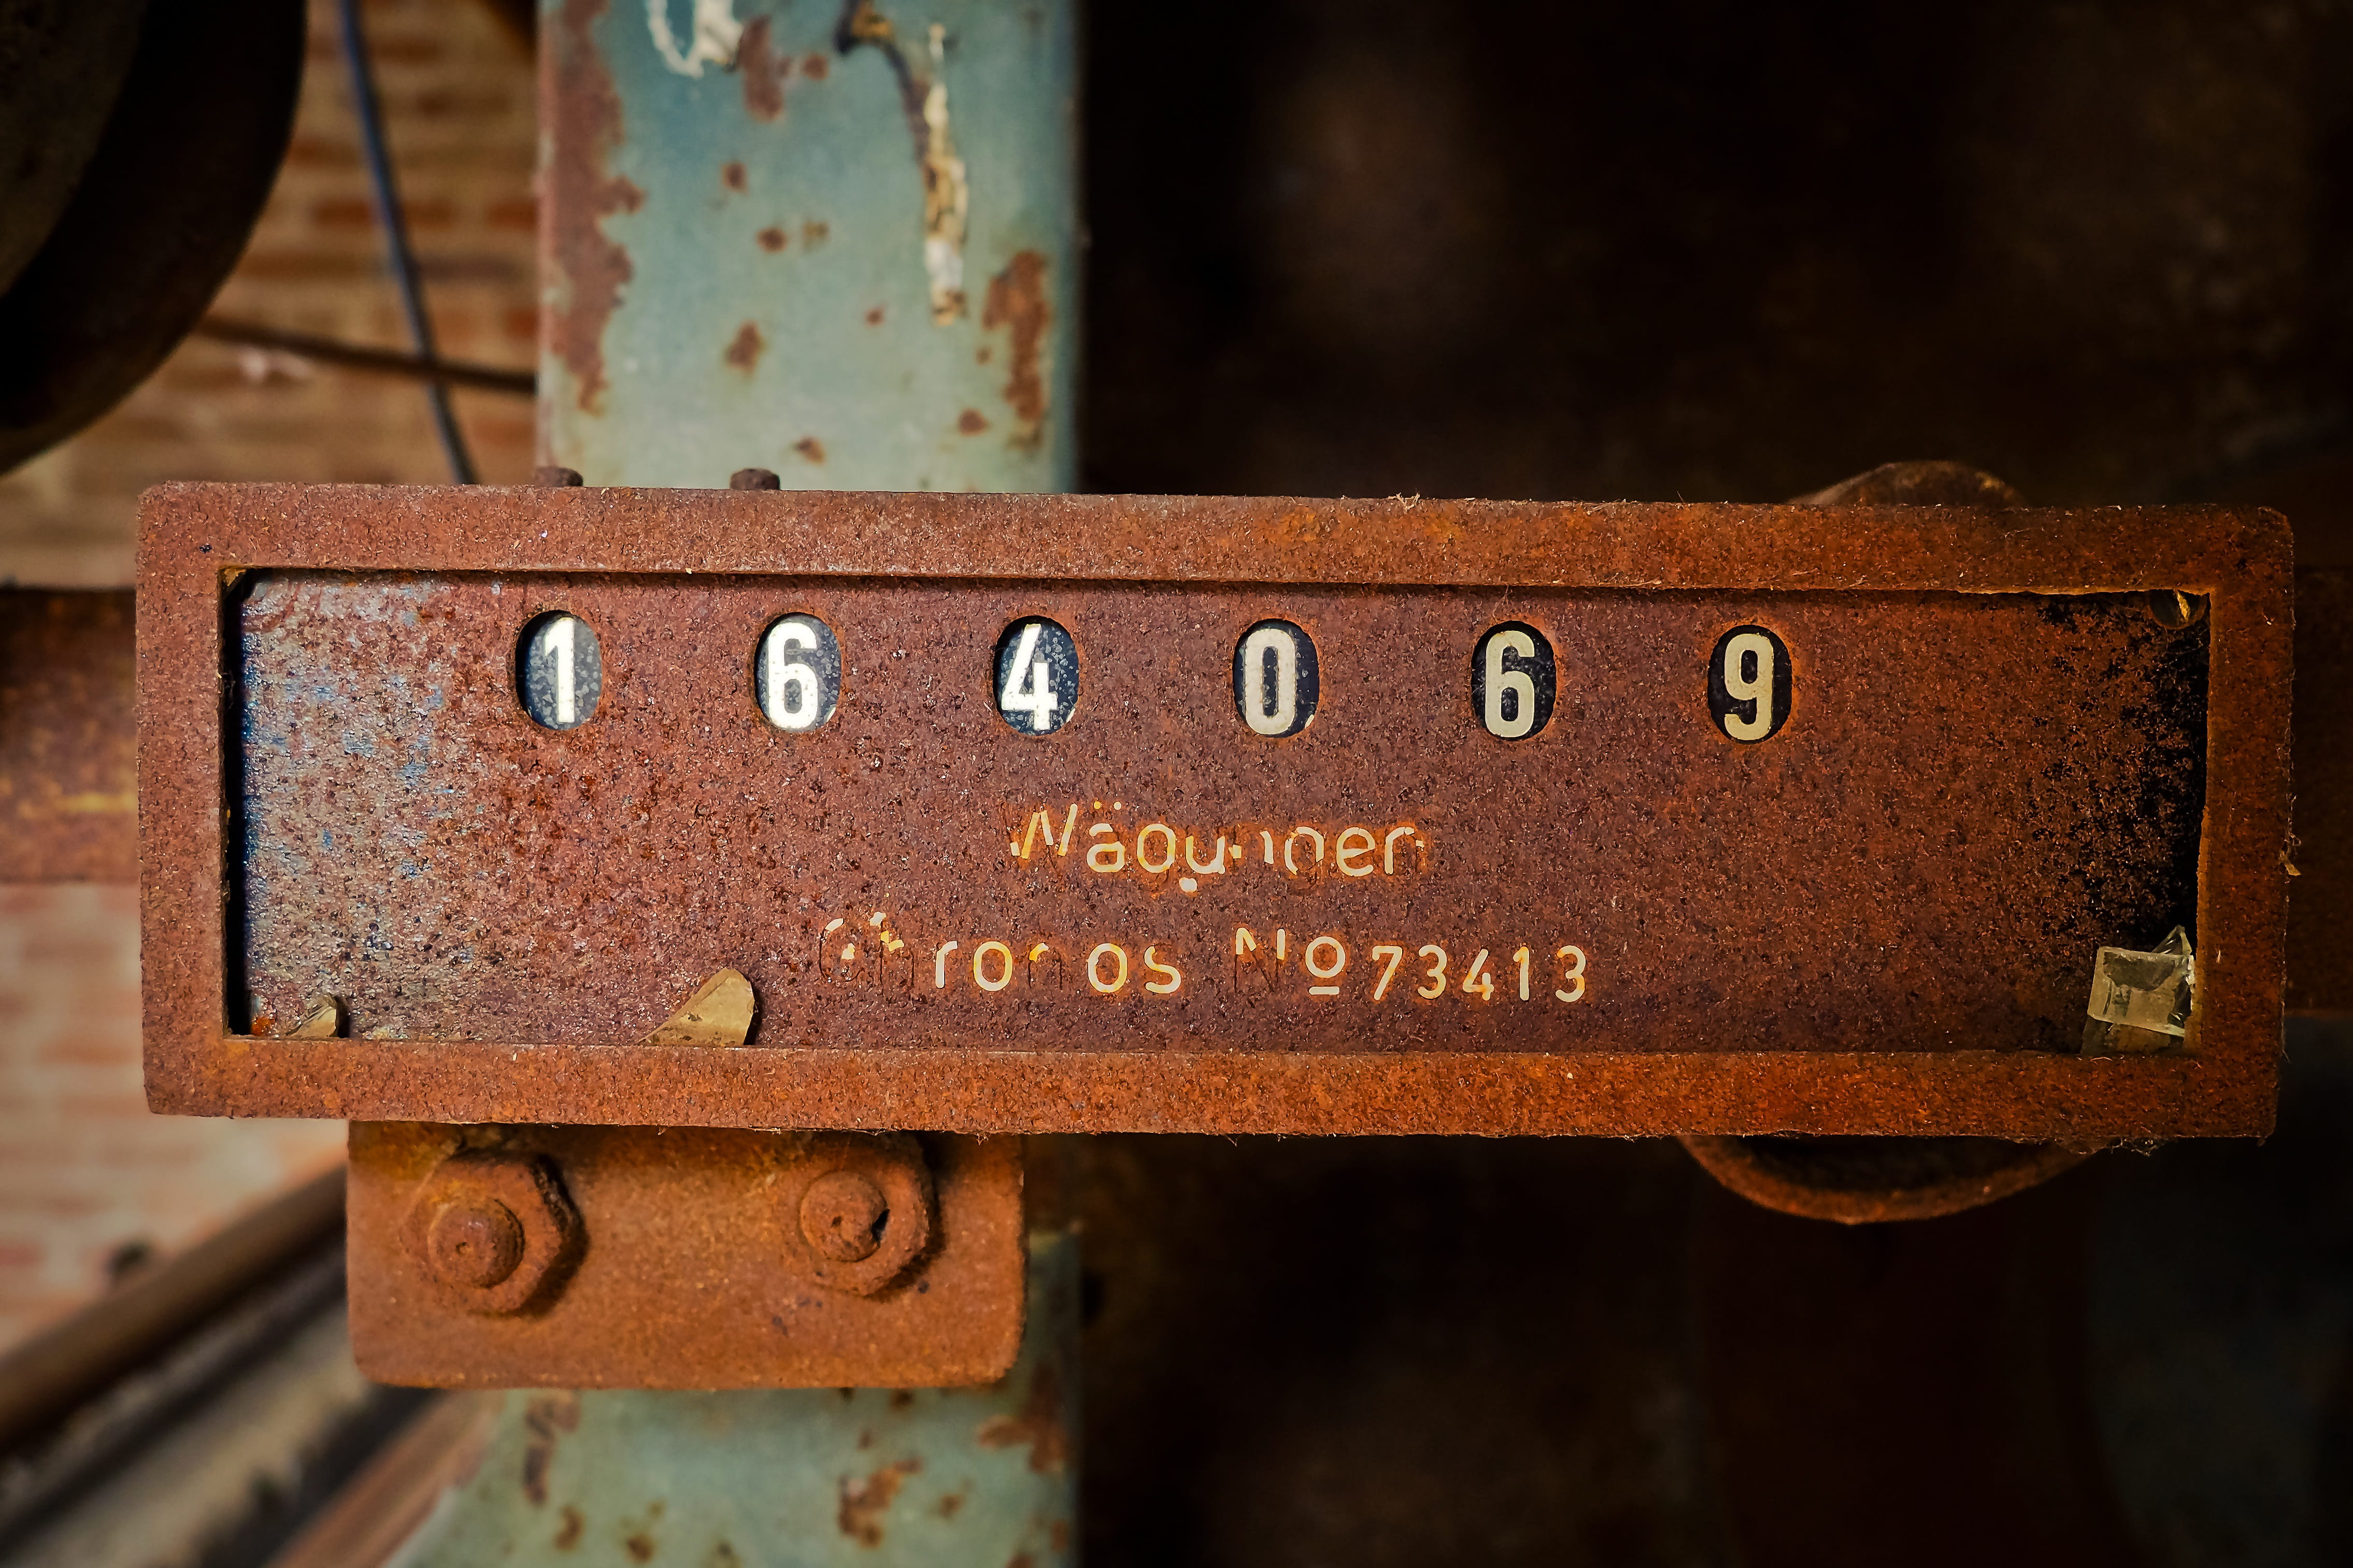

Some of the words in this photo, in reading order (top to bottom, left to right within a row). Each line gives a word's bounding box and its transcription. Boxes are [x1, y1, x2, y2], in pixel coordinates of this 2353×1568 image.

[543, 617, 575, 724] 1
[766, 622, 819, 730] 6
[1001, 623, 1060, 732] 4
[1244, 628, 1299, 735] 0
[1485, 630, 1535, 738] 6
[1724, 634, 1774, 741] 9
[1371, 944, 1588, 1003] 73413
